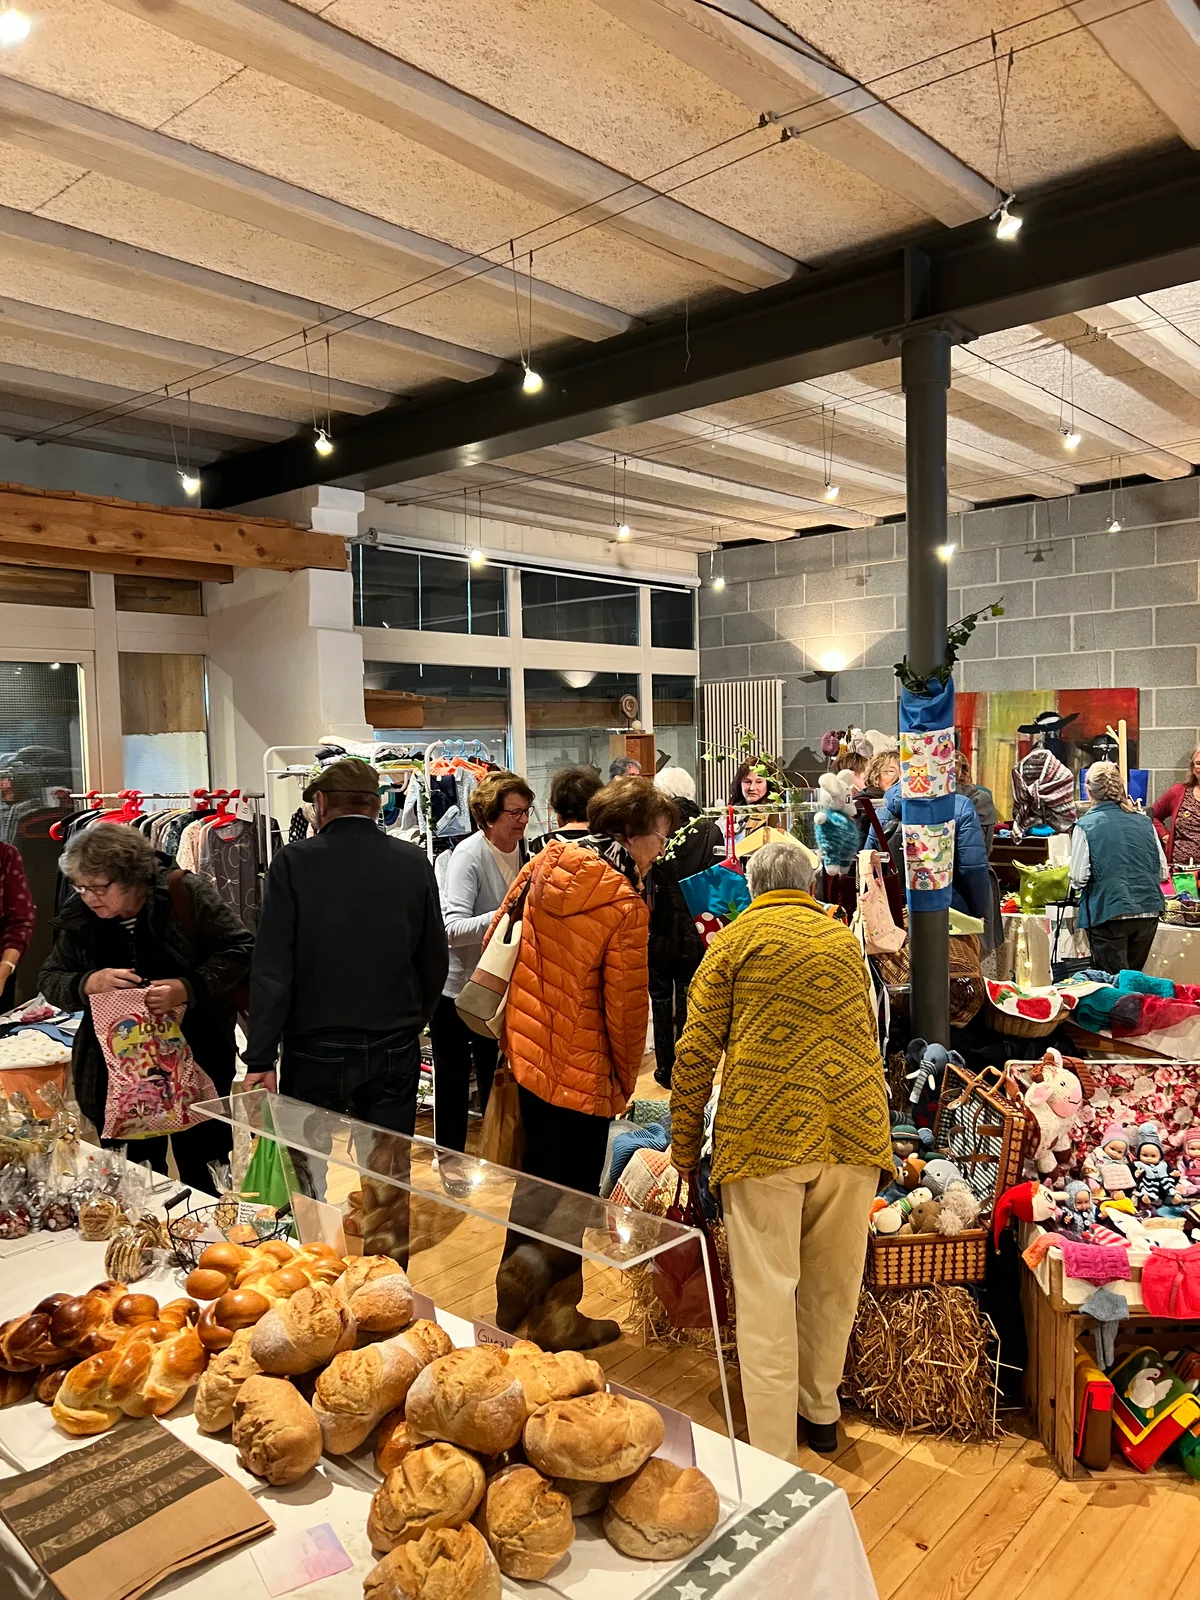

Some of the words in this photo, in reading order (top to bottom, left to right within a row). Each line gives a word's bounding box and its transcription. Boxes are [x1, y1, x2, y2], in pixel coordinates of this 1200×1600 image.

[59, 1457, 132, 1493] NATURA
[80, 1477, 151, 1517] NATUR
[102, 1495, 175, 1538] NATURE
